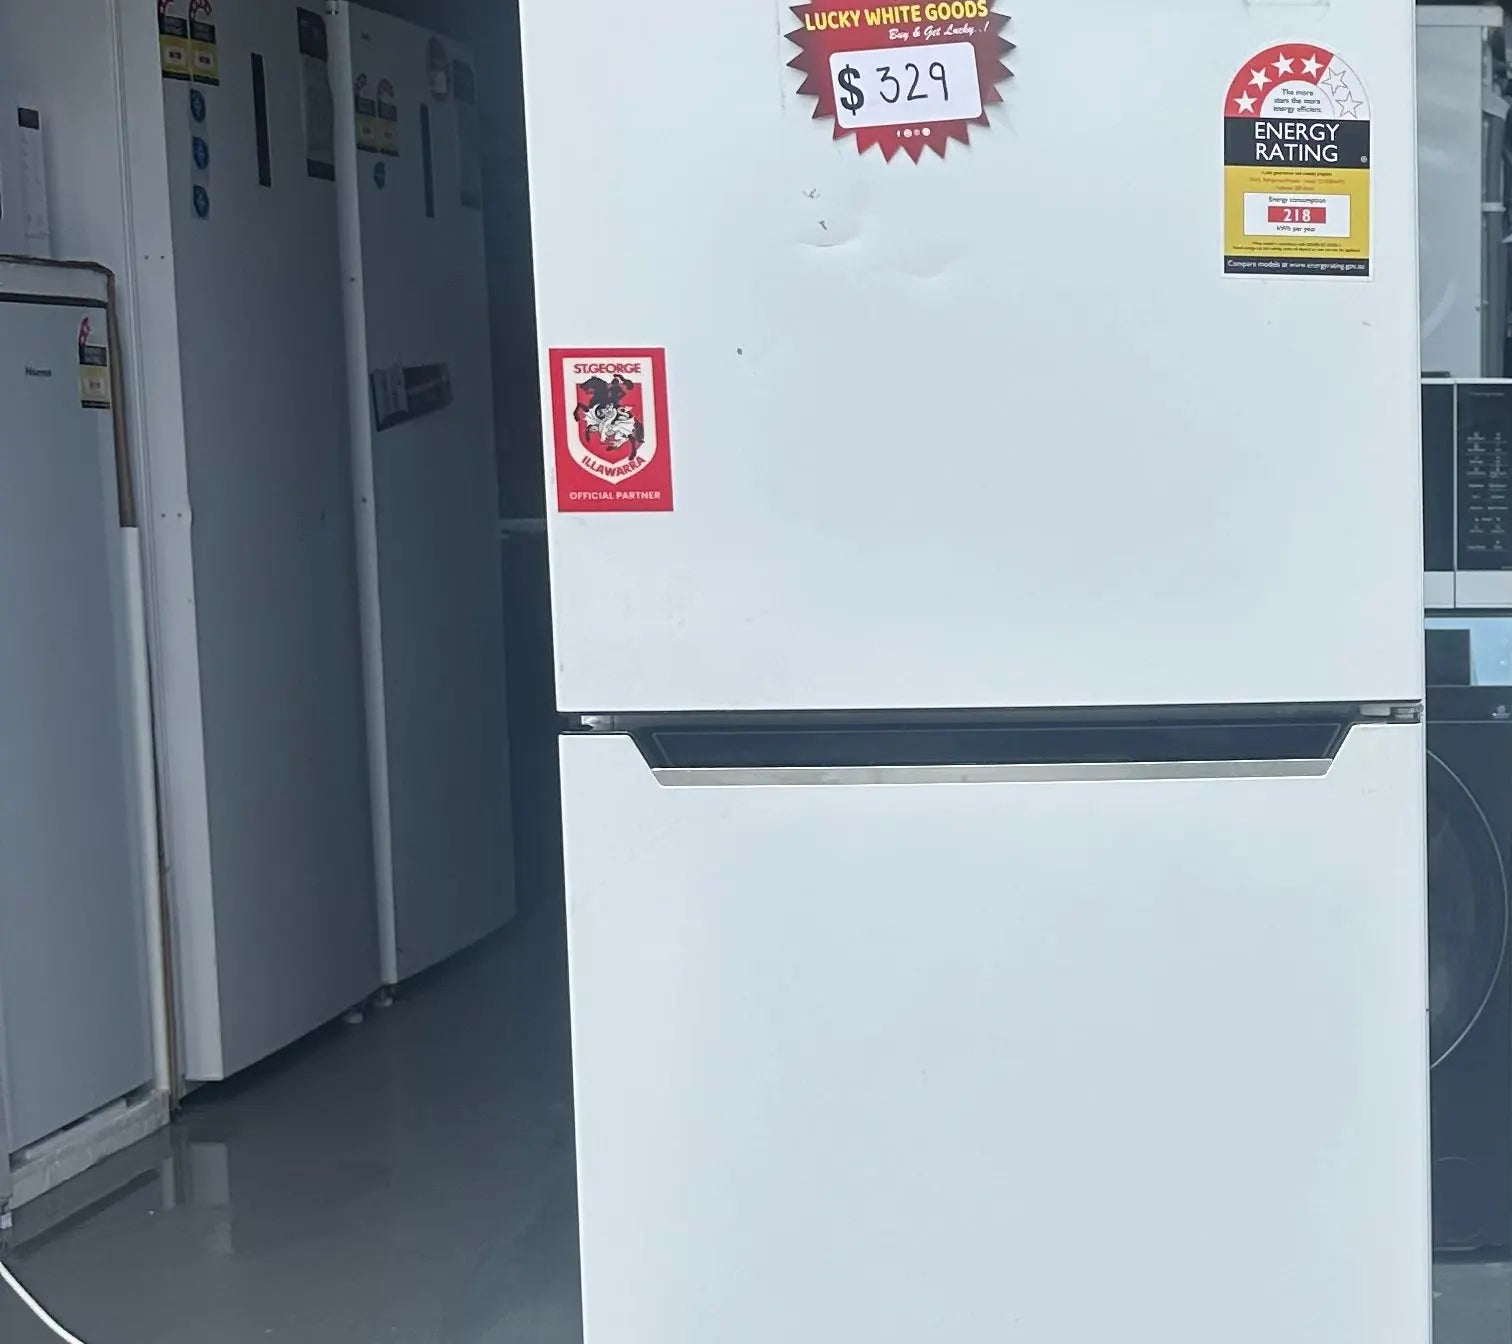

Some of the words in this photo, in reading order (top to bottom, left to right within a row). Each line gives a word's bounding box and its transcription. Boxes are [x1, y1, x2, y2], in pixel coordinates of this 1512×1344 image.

[804, 9, 861, 31] LUCKY
[864, 4, 922, 27] WHITE
[925, 0, 989, 22] GOODS
[888, 27, 909, 41] Buy
[912, 26, 921, 38] &
[923, 25, 941, 40] Get
[1282, 88, 1294, 96] The
[1295, 89, 1314, 97] more
[1254, 121, 1340, 142] ENERGY
[1255, 142, 1338, 163] RATING
[1268, 195, 1288, 204] Energy
[1289, 197, 1327, 205] consumption
[1283, 208, 1311, 222] 218
[1292, 226, 1302, 234] per
[1303, 226, 1316, 234] year
[1227, 259, 1256, 269] Compare
[1257, 261, 1280, 269] models
[581, 455, 647, 478] ILLAWARRA
[569, 491, 614, 500] OFFICIAL
[616, 491, 661, 500] PARTNER
